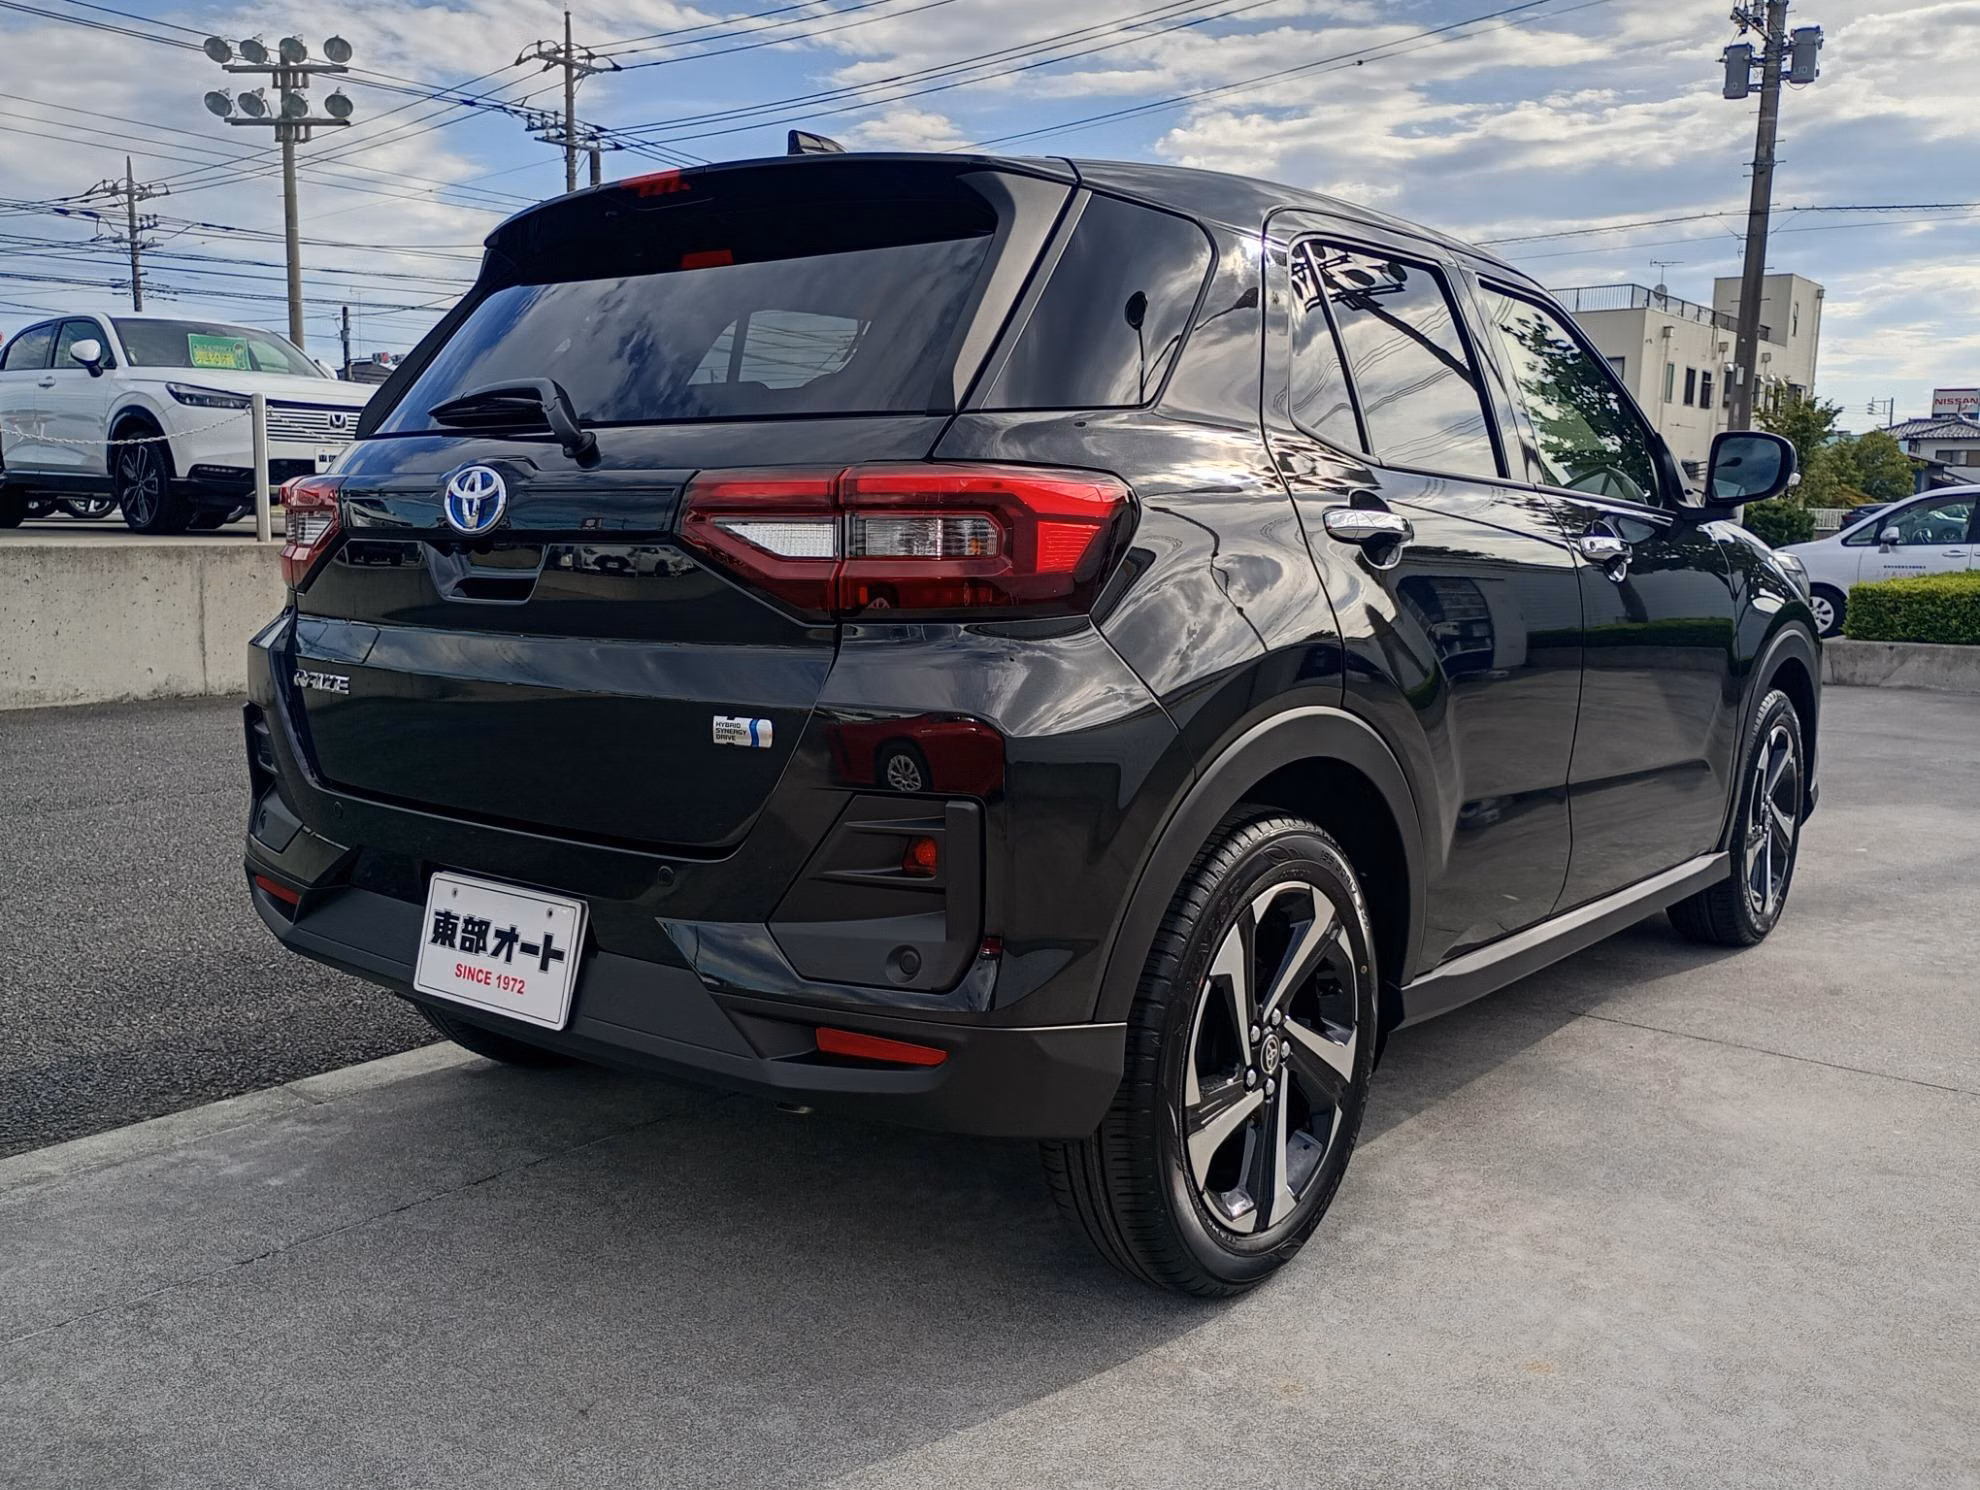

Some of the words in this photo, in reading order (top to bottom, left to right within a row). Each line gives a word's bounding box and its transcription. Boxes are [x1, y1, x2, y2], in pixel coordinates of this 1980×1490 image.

[1935, 397, 1979, 405] NISSAN
[715, 721, 742, 729] HYBRID
[715, 728, 747, 736] SYNERGY
[715, 734, 737, 742] DRIVE
[430, 909, 566, 973] 東部オート
[454, 963, 493, 986] SINCE
[496, 973, 526, 995] 1972
